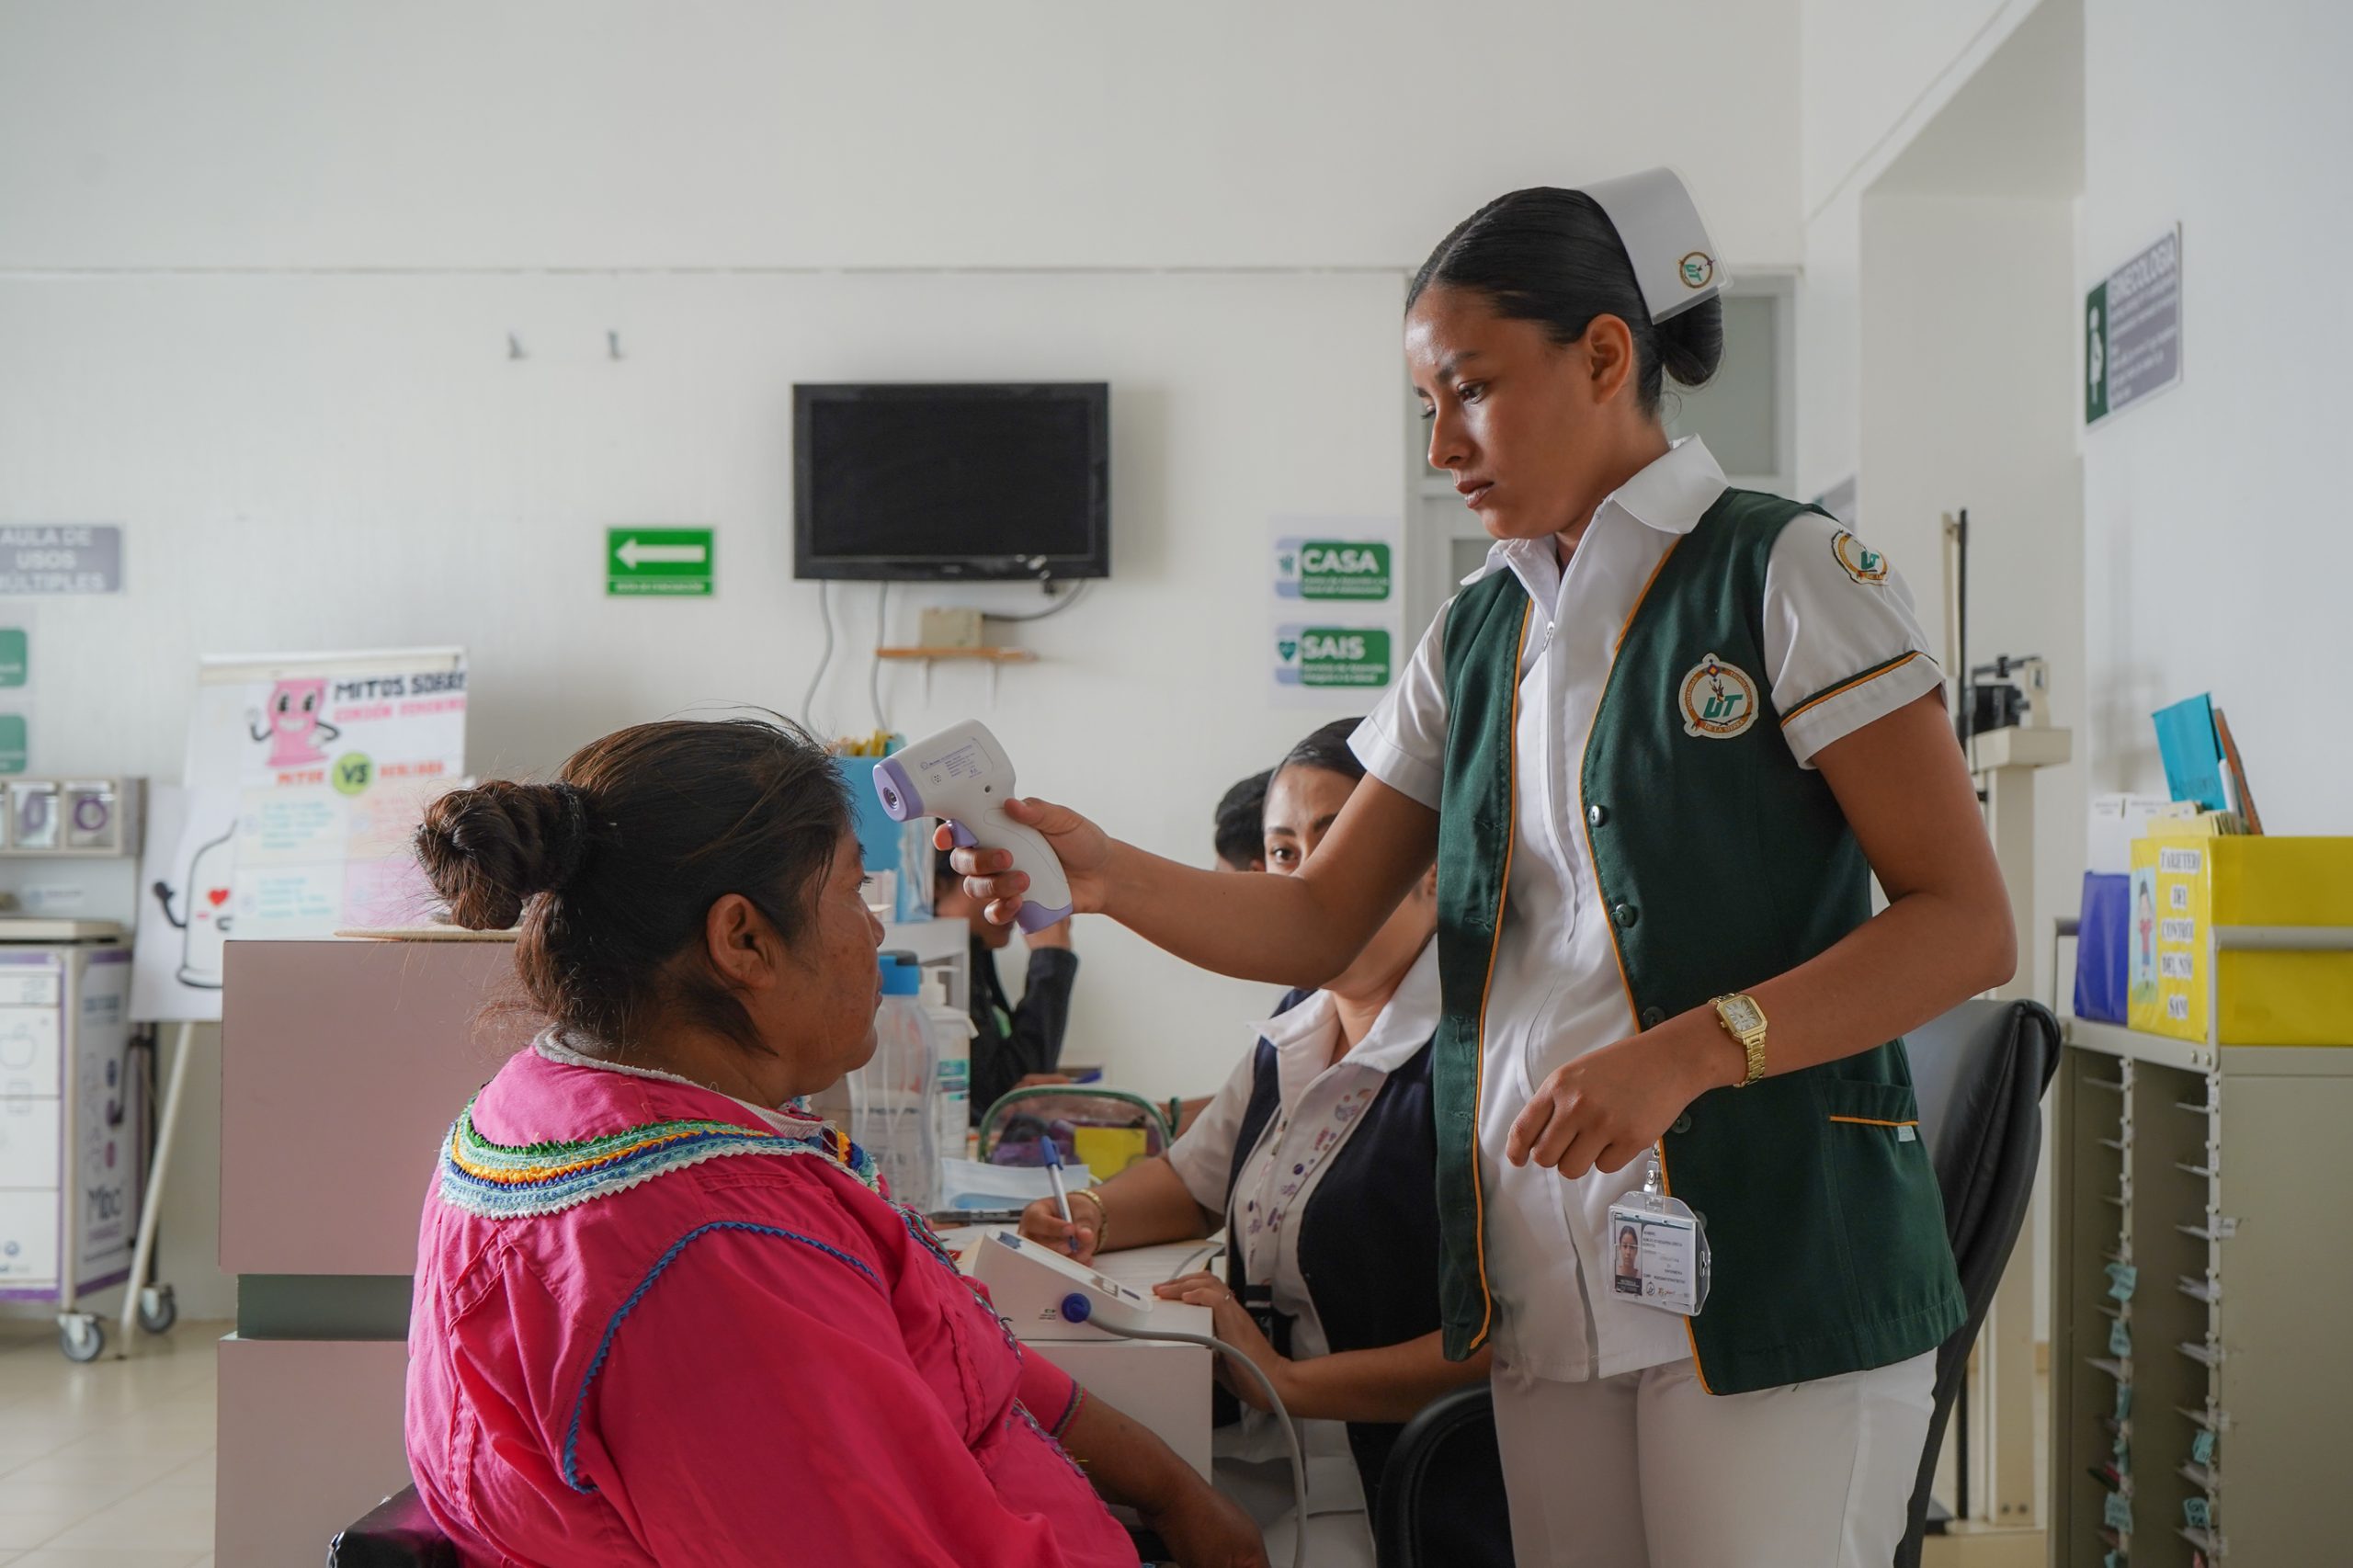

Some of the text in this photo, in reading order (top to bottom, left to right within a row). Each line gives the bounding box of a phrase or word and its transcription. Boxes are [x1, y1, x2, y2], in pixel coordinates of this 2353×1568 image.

[62, 529, 92, 547] DE
[17, 550, 77, 569] USOS
[1302, 548, 1381, 574] CASA
[1302, 634, 1366, 661] SAIS
[334, 676, 404, 700] MITOS
[1703, 694, 1743, 719] UT
[341, 764, 369, 783] VS
